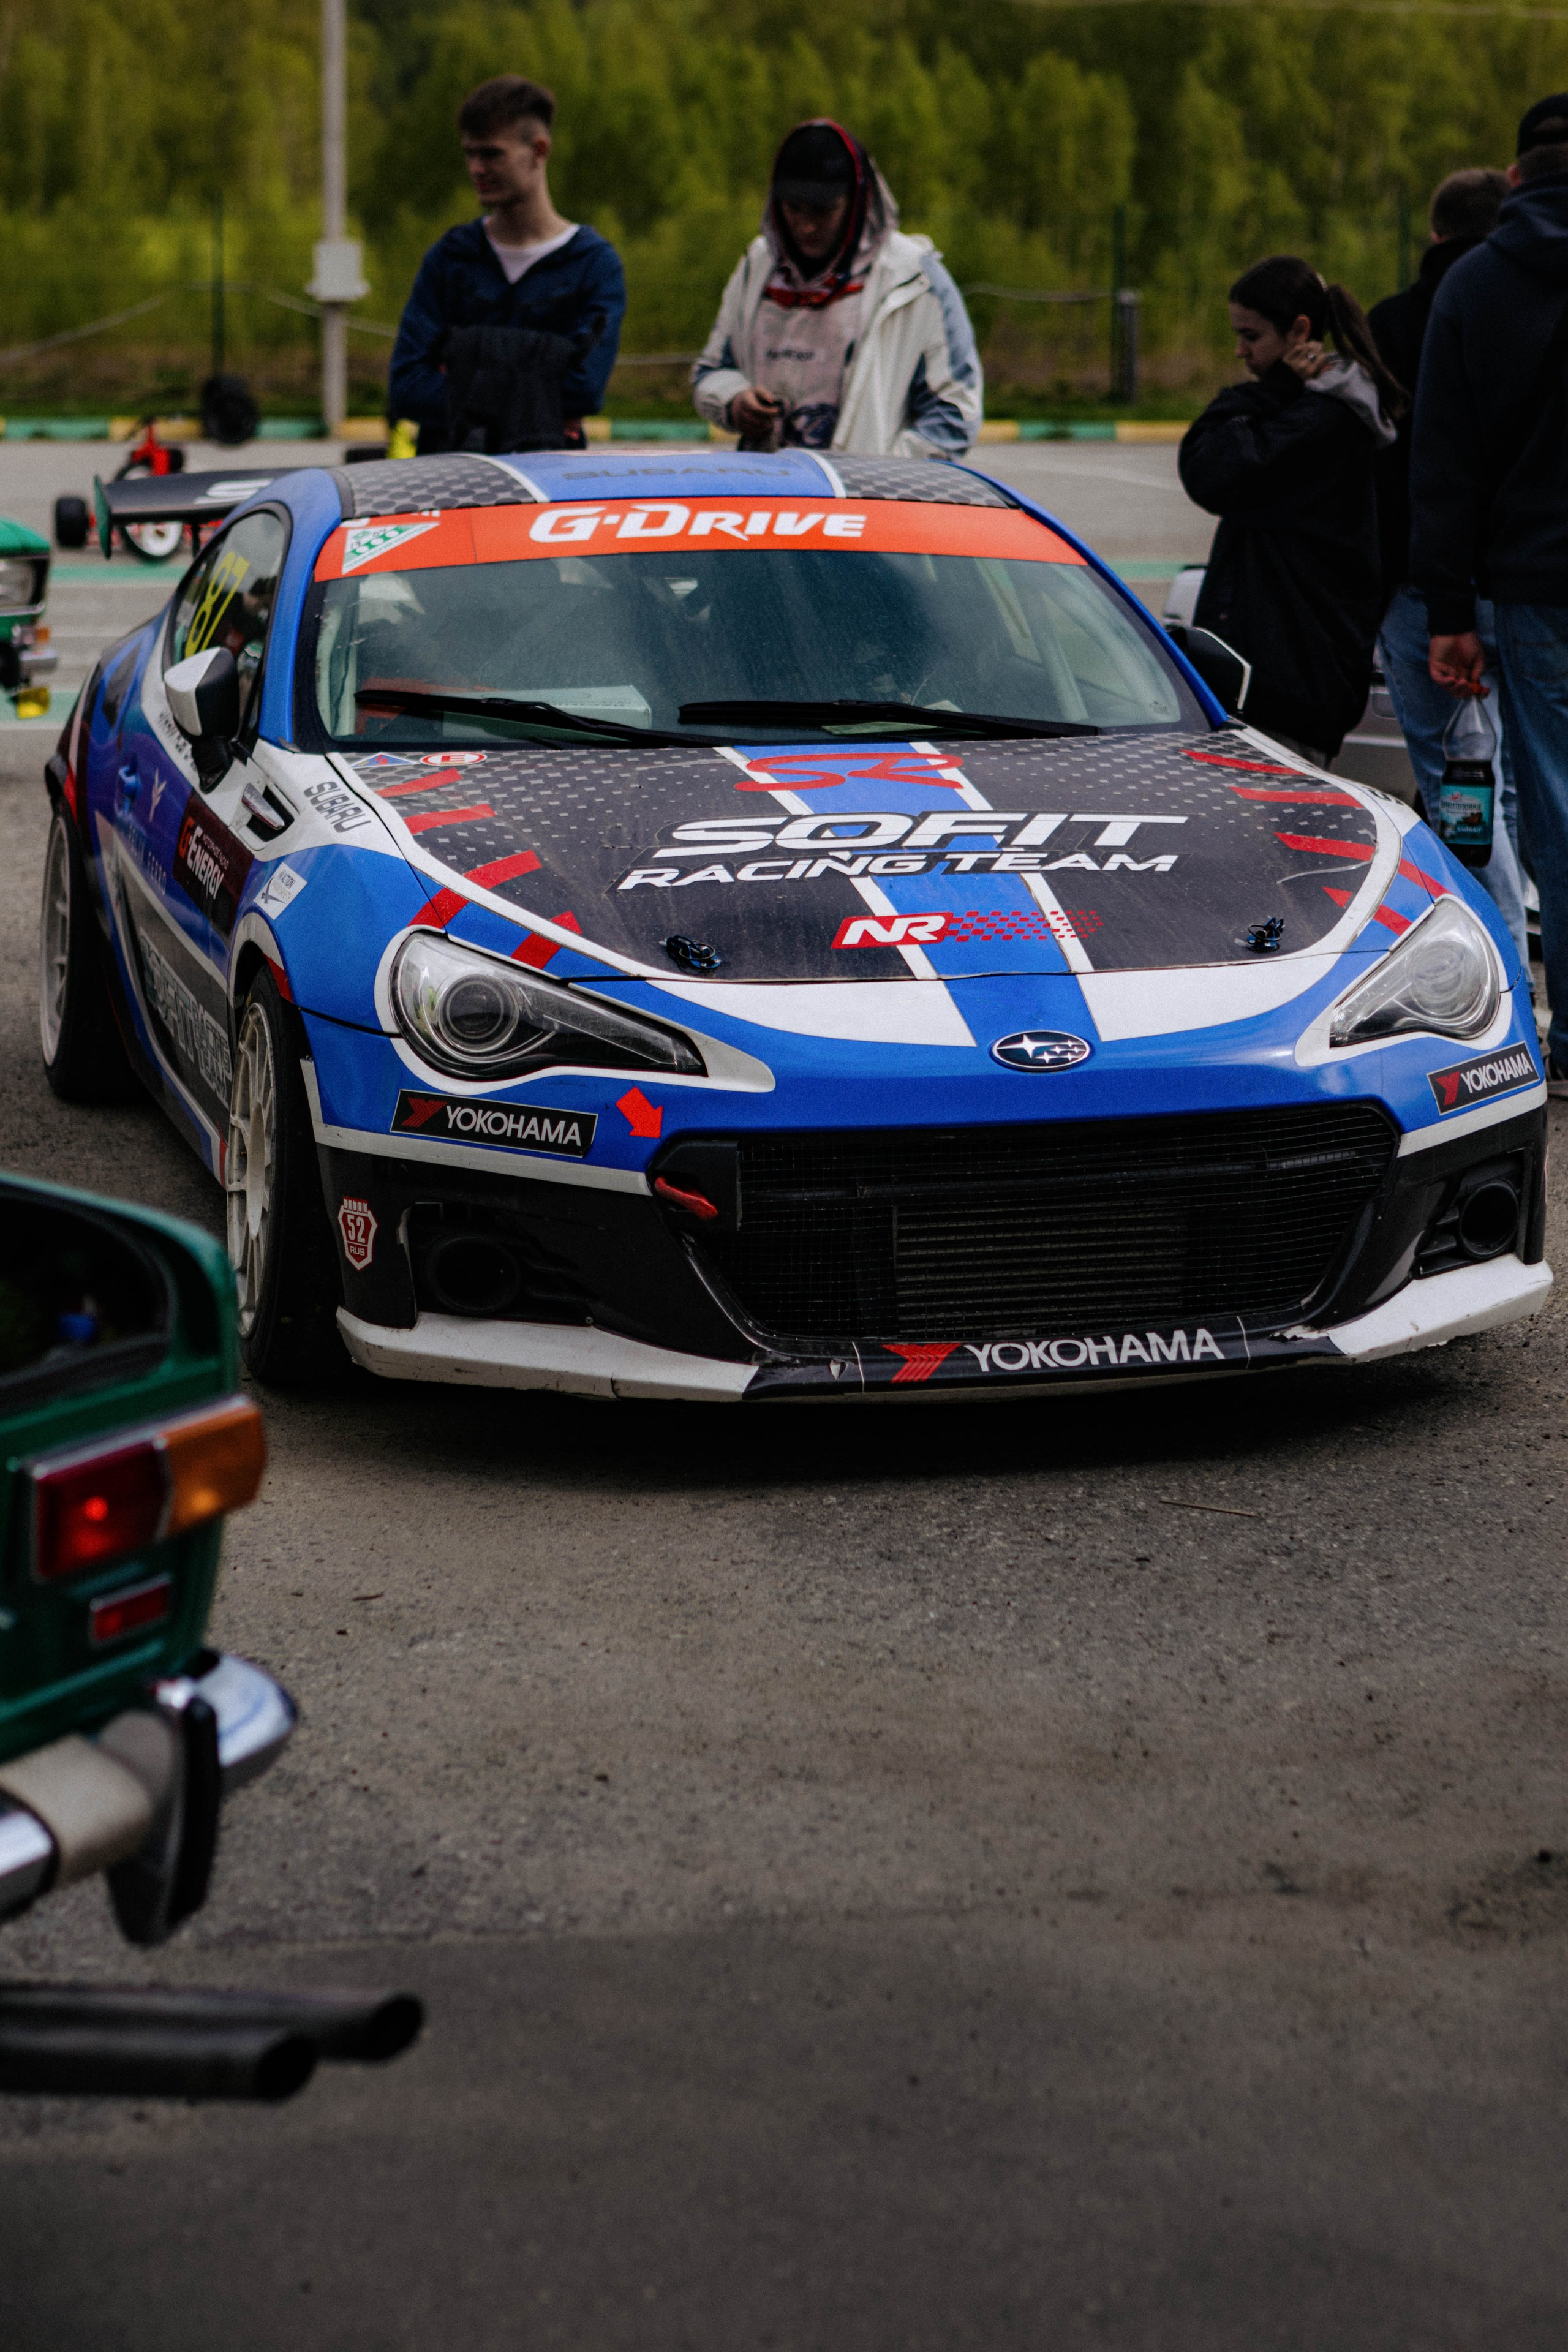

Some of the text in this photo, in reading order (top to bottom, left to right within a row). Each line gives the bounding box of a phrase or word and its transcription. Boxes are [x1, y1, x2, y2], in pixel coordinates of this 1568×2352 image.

[562, 466, 790, 480] SUBARU
[184, 551, 251, 658] 87
[734, 753, 963, 792] SR
[304, 782, 371, 833] SUBARU
[652, 812, 1189, 859] SOFIT
[617, 852, 1178, 891] RACING TEAM
[842, 915, 948, 945] NR
[1461, 1052, 1534, 1094] YOKOHAMA
[446, 1105, 582, 1147] YOKOHAMA
[347, 1214, 366, 1244] 52
[349, 1246, 365, 1256] RUS
[964, 1327, 1225, 1372] YOKOHAMA
